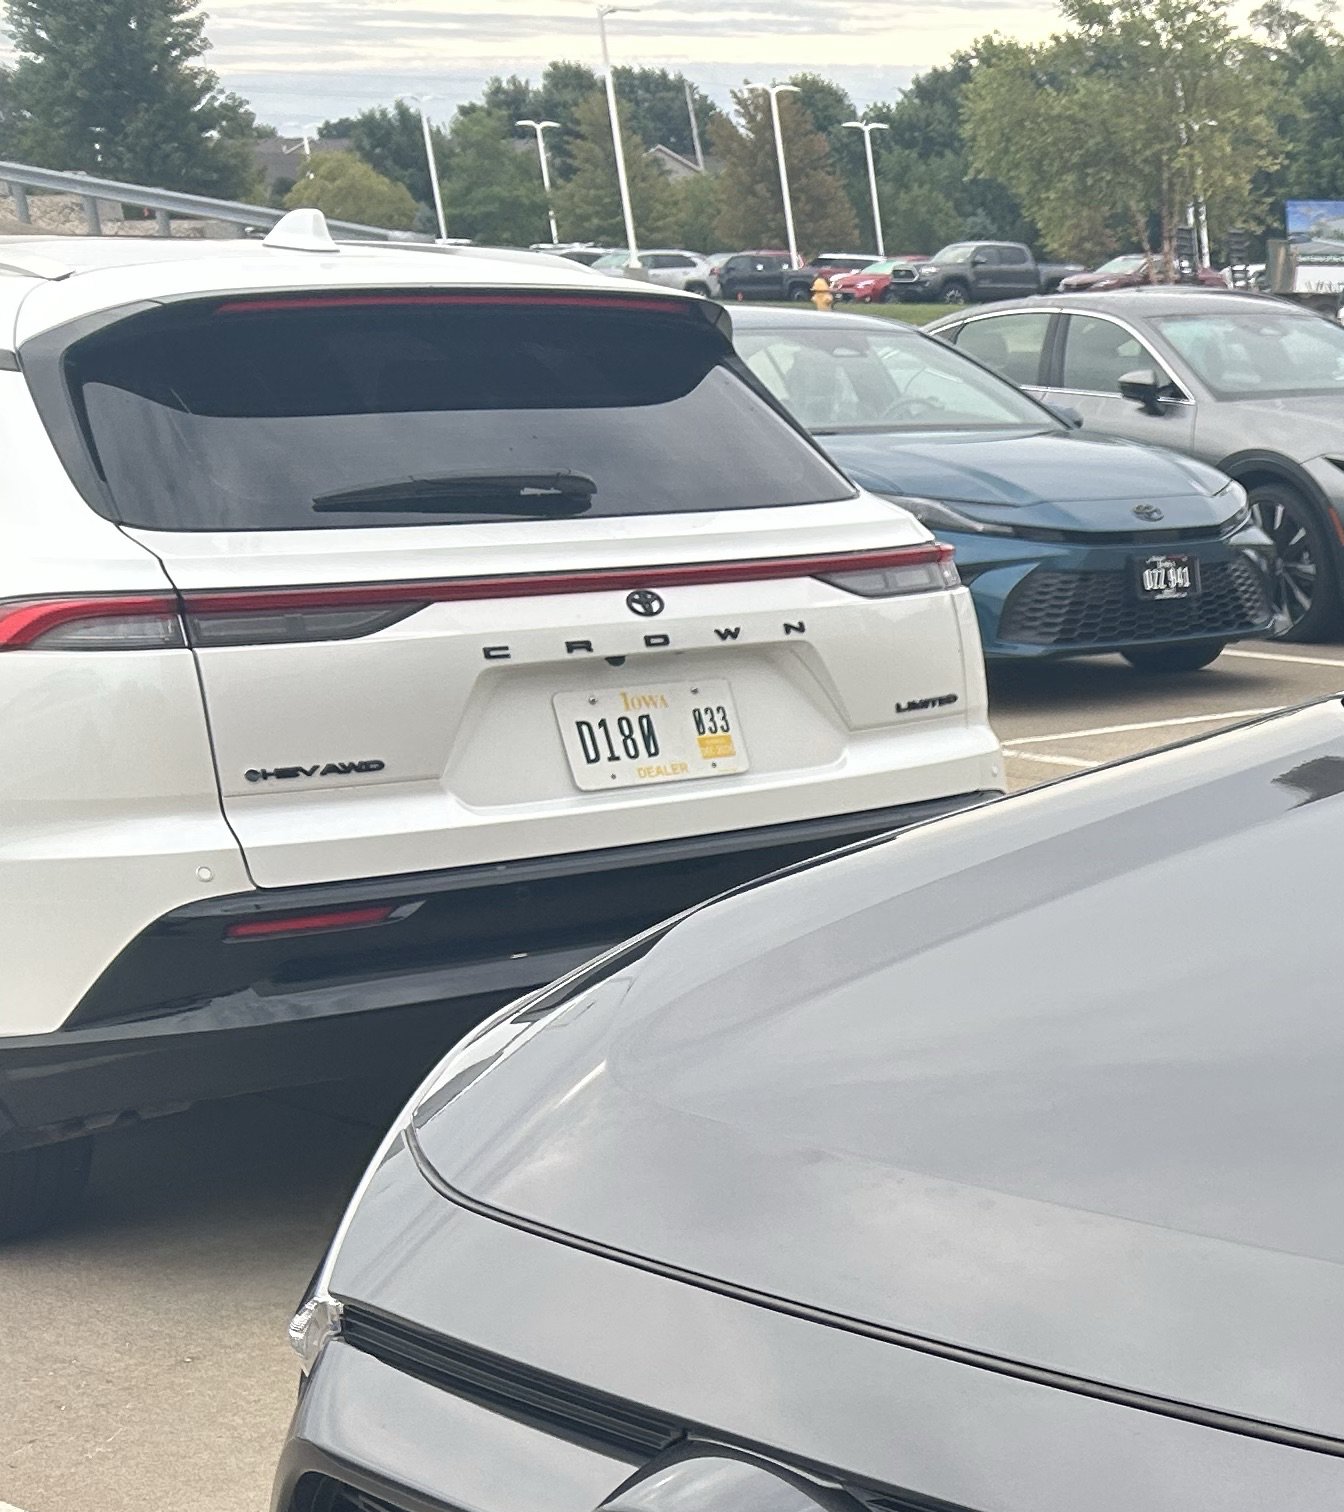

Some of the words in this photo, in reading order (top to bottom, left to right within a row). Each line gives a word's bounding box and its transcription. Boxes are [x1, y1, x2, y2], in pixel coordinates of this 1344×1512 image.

[482, 621, 806, 660] CROWN
[576, 714, 660, 765] D180
[692, 706, 730, 736] 033
[636, 762, 689, 779] DEALER
